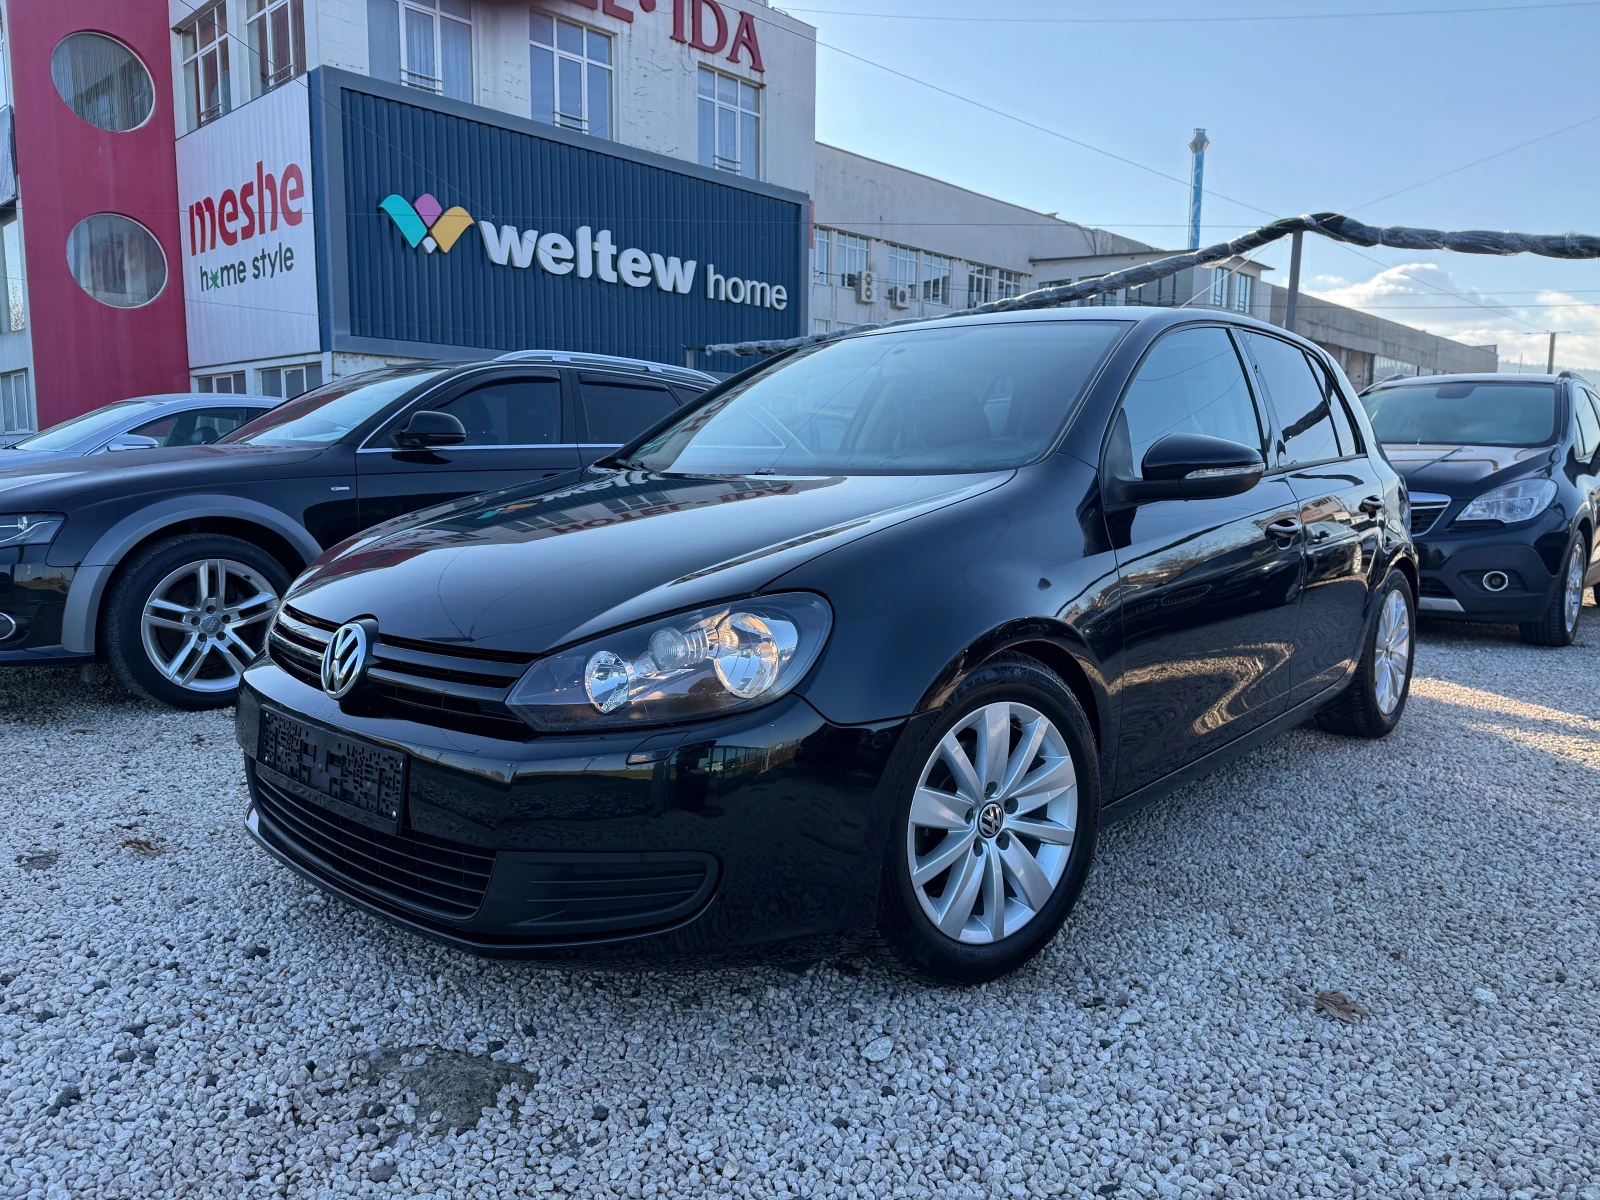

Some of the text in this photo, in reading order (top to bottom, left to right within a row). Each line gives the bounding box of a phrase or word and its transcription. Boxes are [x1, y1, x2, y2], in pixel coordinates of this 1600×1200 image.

[669, 0, 765, 73] IDA
[188, 160, 305, 257] meshe
[252, 241, 295, 279] style
[478, 219, 788, 311] weltew home
